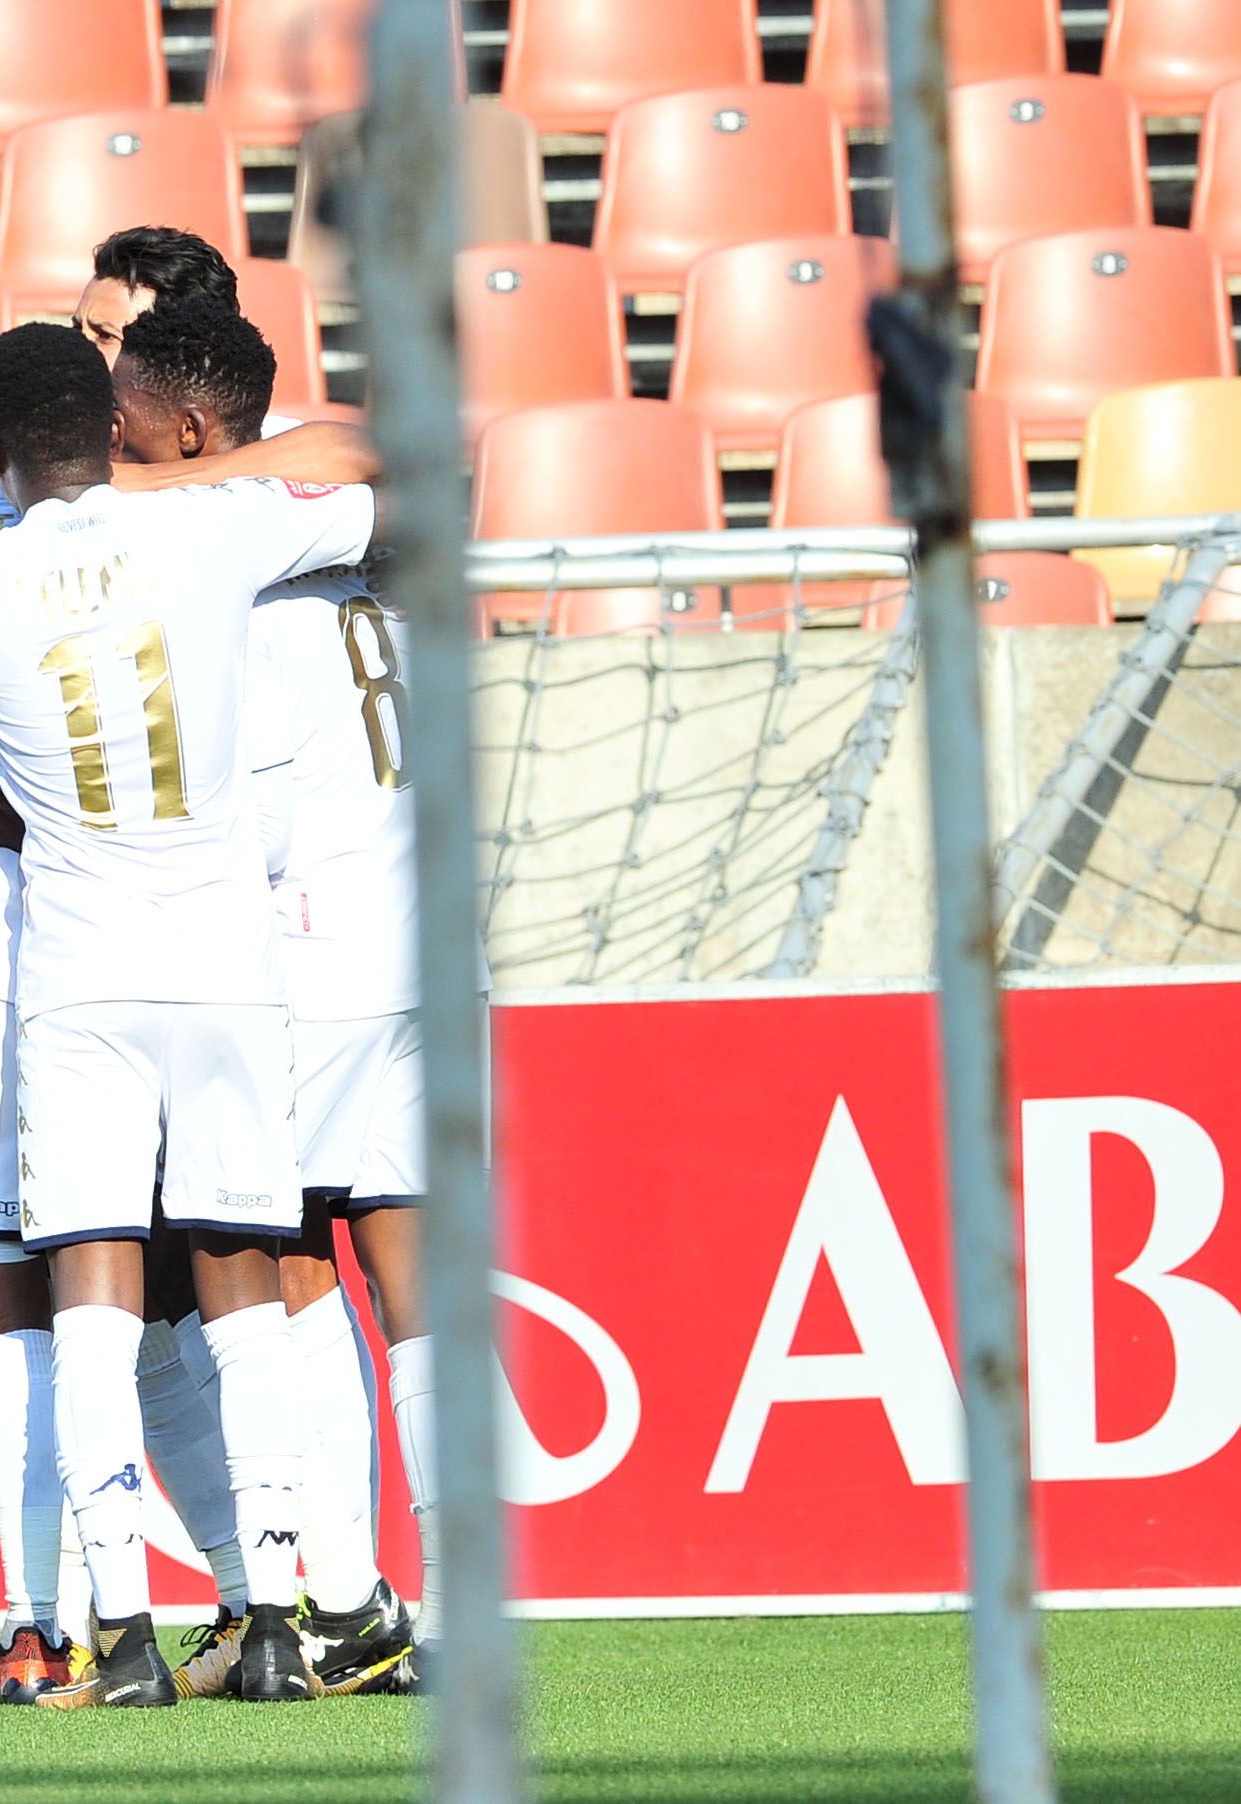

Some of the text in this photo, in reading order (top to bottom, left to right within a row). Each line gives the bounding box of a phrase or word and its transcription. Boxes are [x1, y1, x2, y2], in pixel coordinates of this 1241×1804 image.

[38, 620, 194, 832] 11
[338, 594, 414, 792] 8
[216, 1188, 272, 1209] Kappa
[704, 1094, 1241, 1493] AB
